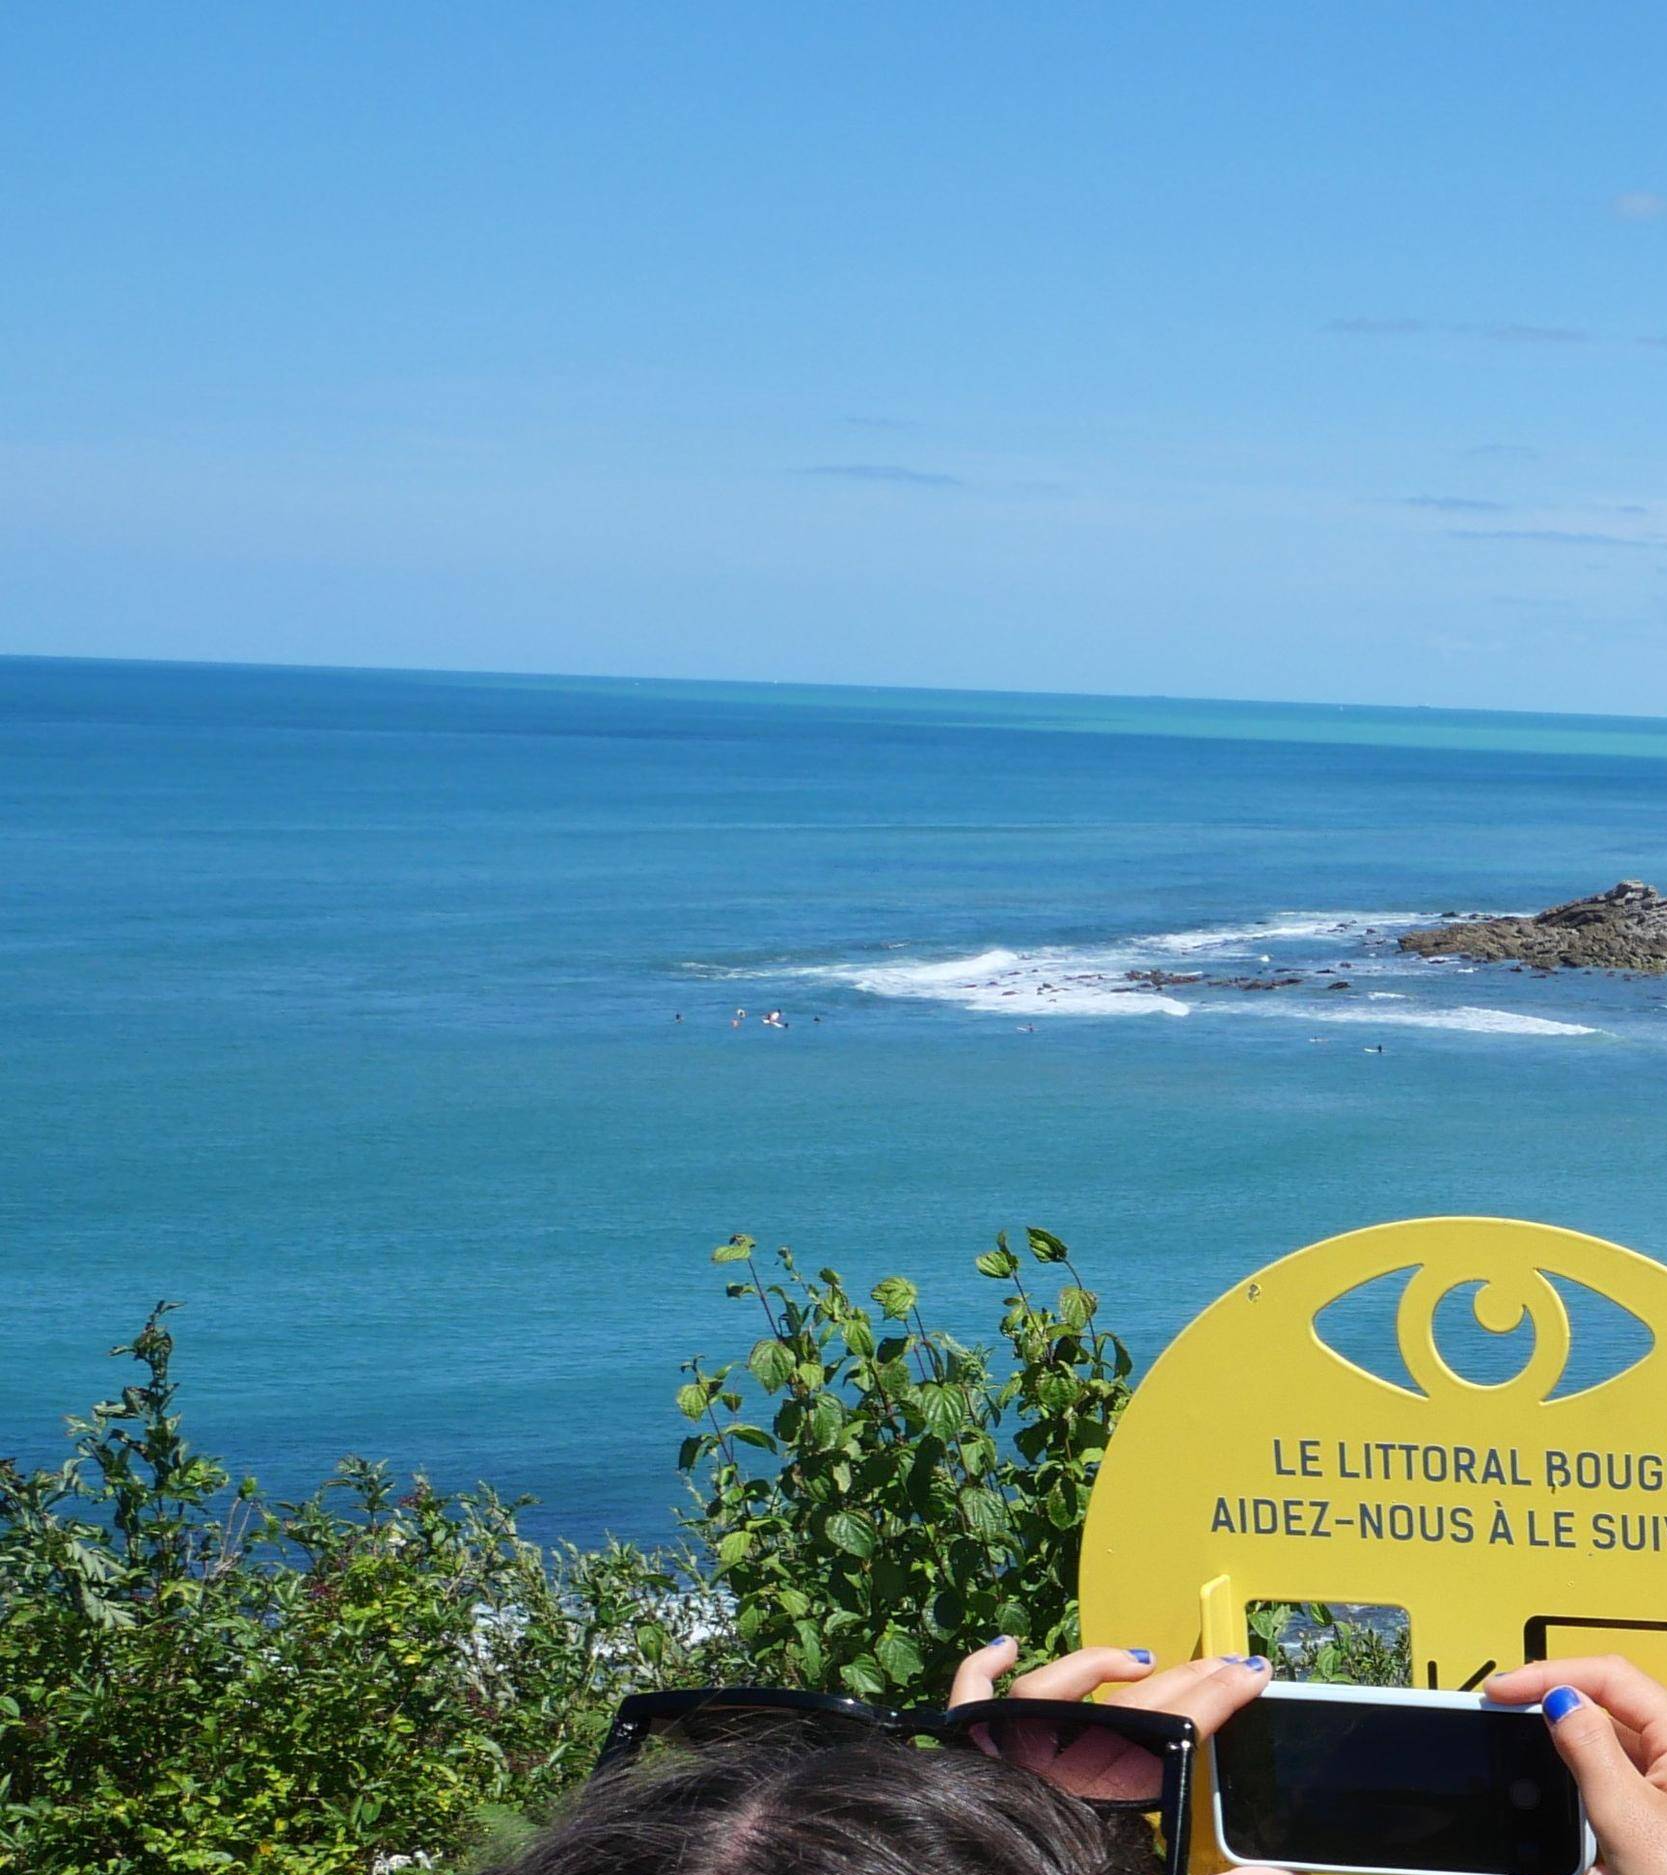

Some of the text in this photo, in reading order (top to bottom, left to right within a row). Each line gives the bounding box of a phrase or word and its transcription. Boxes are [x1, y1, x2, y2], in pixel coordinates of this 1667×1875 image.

[1273, 1438, 1323, 1477] LE
[1338, 1441, 1532, 1486] LITTORAL
[1211, 1496, 1475, 1543] AIDEZ-NOUS
[1488, 1500, 1515, 1546] À
[1527, 1510, 1576, 1548] LE
